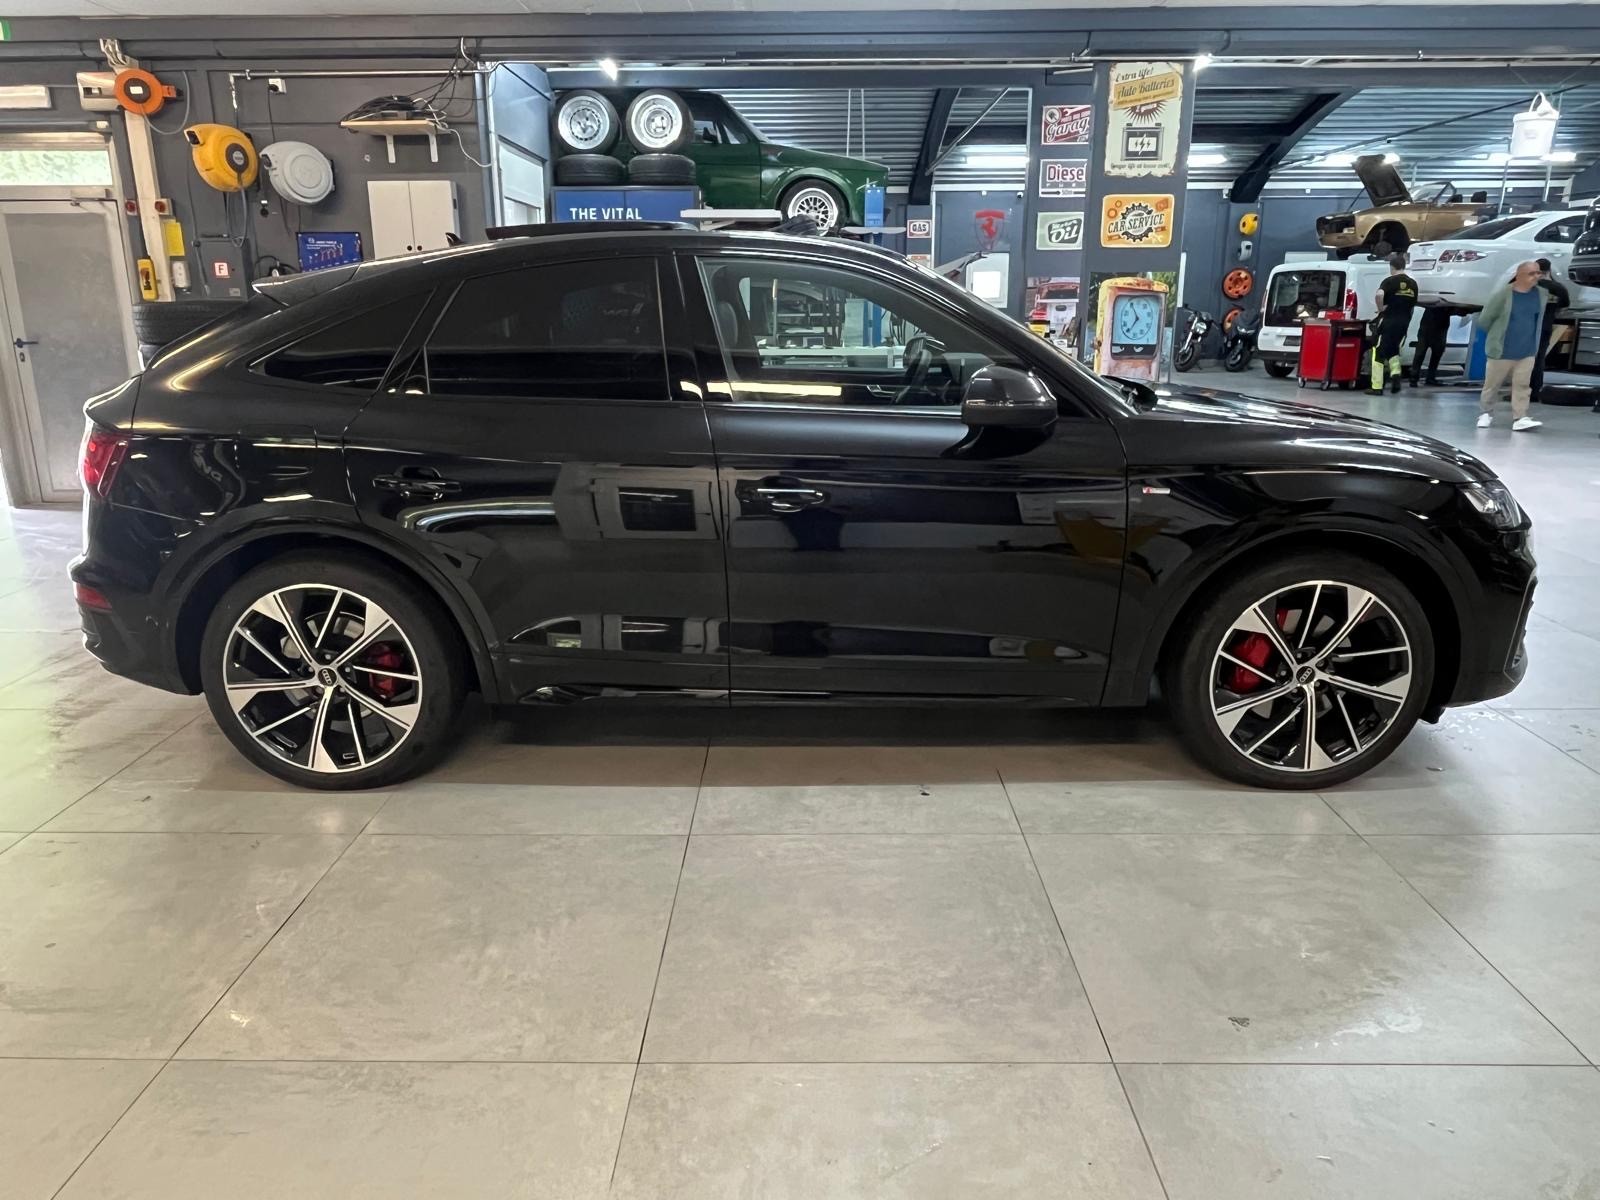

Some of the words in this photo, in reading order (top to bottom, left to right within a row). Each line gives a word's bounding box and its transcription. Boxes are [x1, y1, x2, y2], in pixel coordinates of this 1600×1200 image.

[1139, 78, 1175, 94] Batteries
[1046, 117, 1090, 143] Garag
[569, 207, 598, 220] THE
[601, 207, 643, 220] VITAL
[912, 223, 927, 232] GAS
[1108, 220, 1127, 234] CAR
[1127, 213, 1165, 231] SERVICE
[218, 264, 225, 274] F
